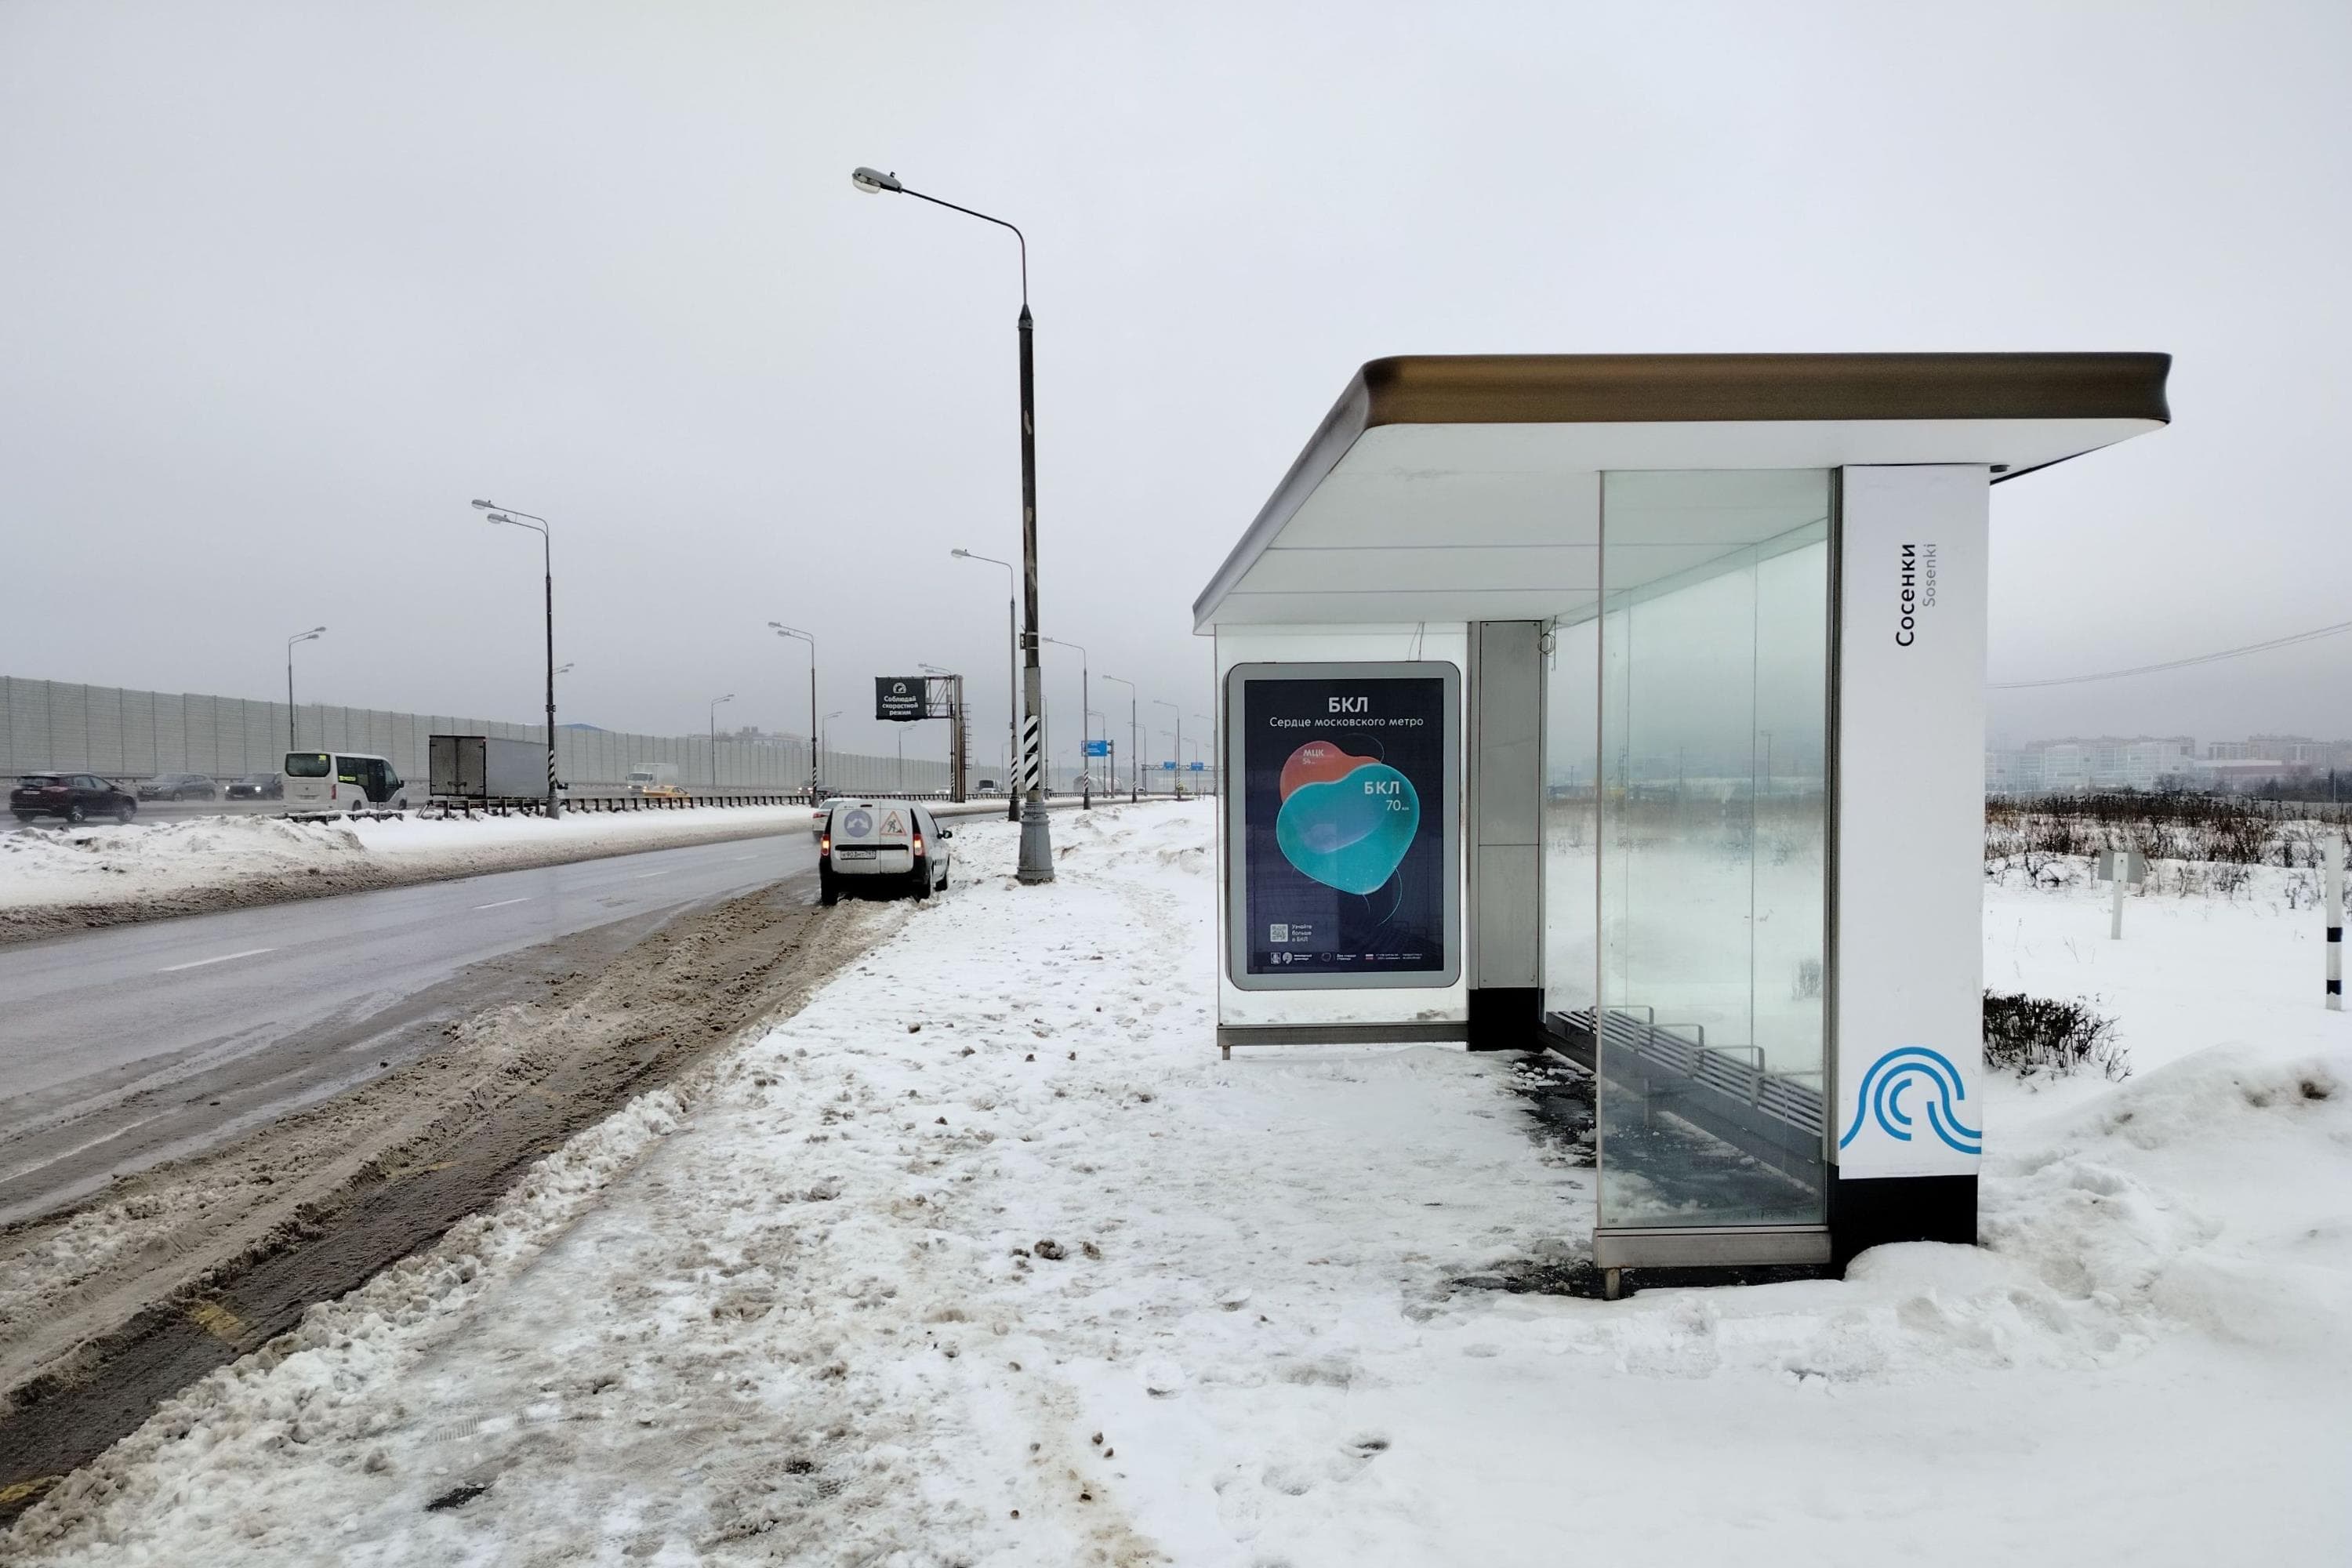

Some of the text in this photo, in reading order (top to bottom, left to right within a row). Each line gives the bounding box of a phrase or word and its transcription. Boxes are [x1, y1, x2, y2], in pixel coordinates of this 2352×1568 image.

[1922, 543, 1936, 607] Sosenki
[1896, 544, 1915, 647] Сосенки
[1328, 697, 1368, 713] БКЛ
[1269, 717, 1424, 728] Сердце московского метро
[1303, 749, 1324, 757] МЦК
[1364, 781, 1399, 794] БКЛ
[1385, 800, 1401, 811] 70
